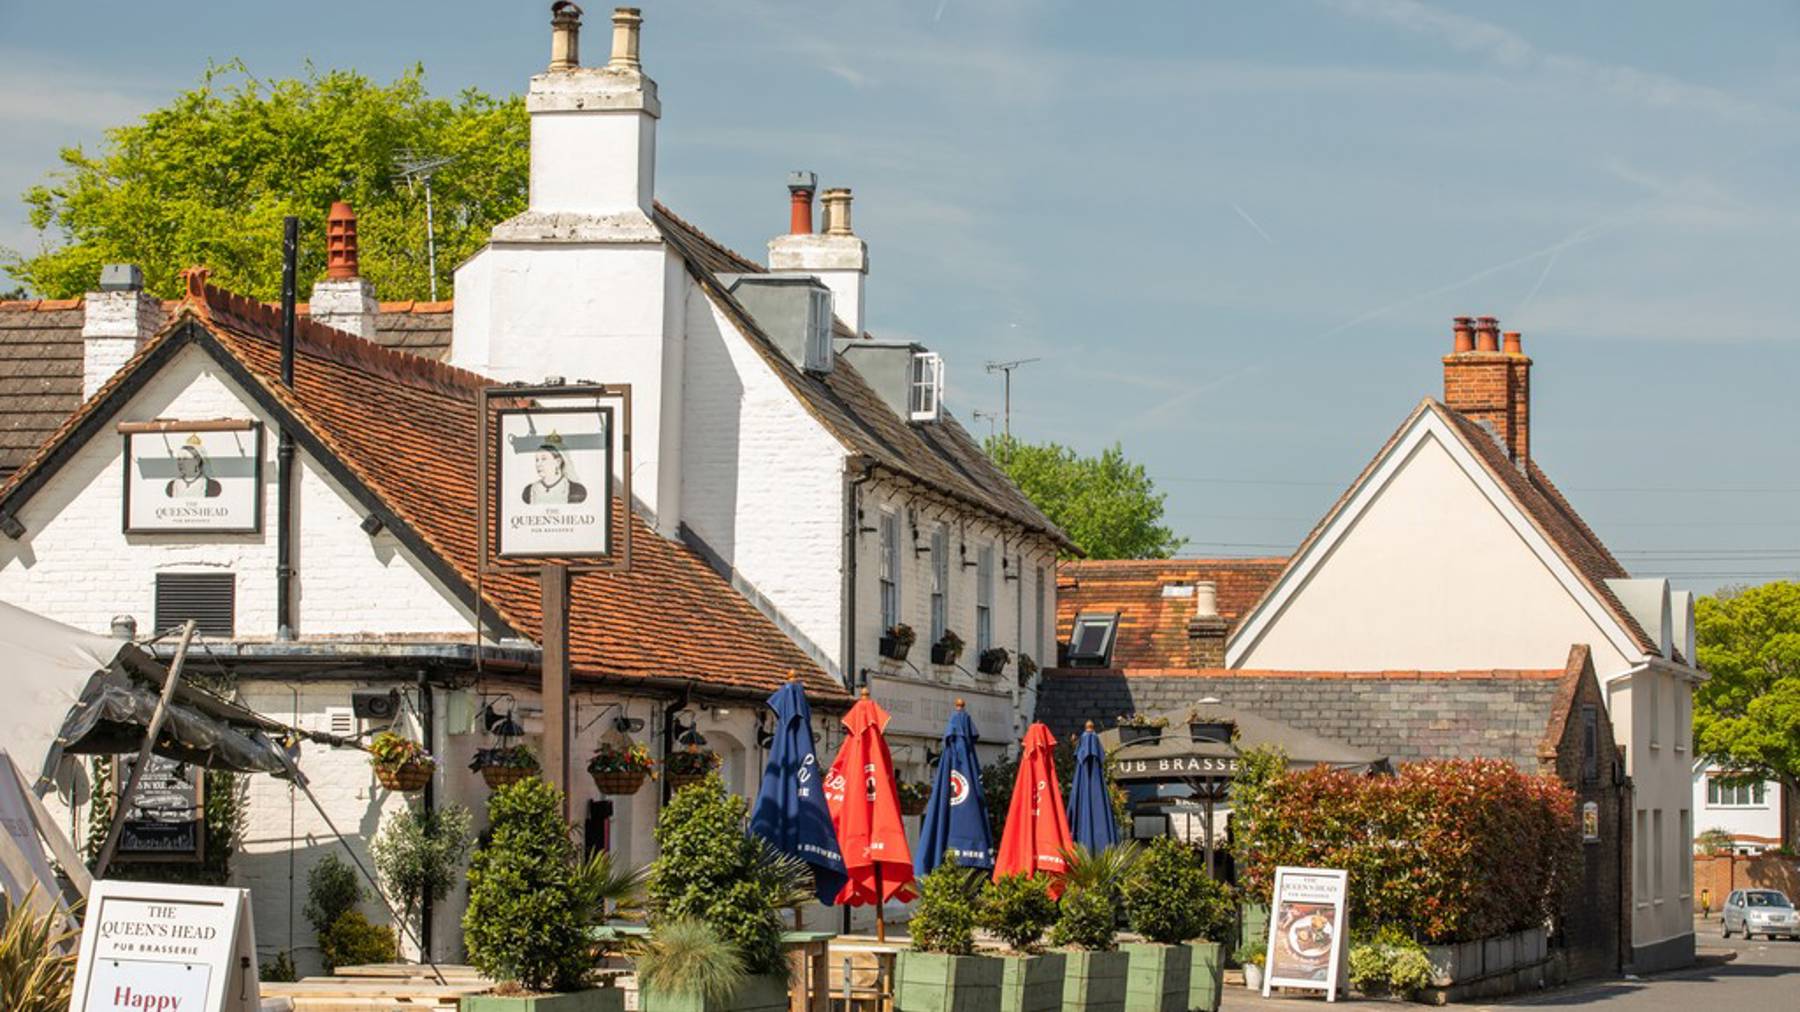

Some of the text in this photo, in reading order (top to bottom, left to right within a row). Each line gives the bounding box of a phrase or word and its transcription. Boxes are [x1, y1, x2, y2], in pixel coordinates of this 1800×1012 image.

[199, 507, 229, 517] HEAD
[561, 514, 595, 525] HEAD
[1117, 758, 1240, 772] UB BRASSE
[147, 905, 177, 919] THE
[101, 921, 216, 940] QUEEN'S HEAD
[113, 942, 198, 956] PUB BRASSERIE
[113, 986, 183, 1012] Happy
